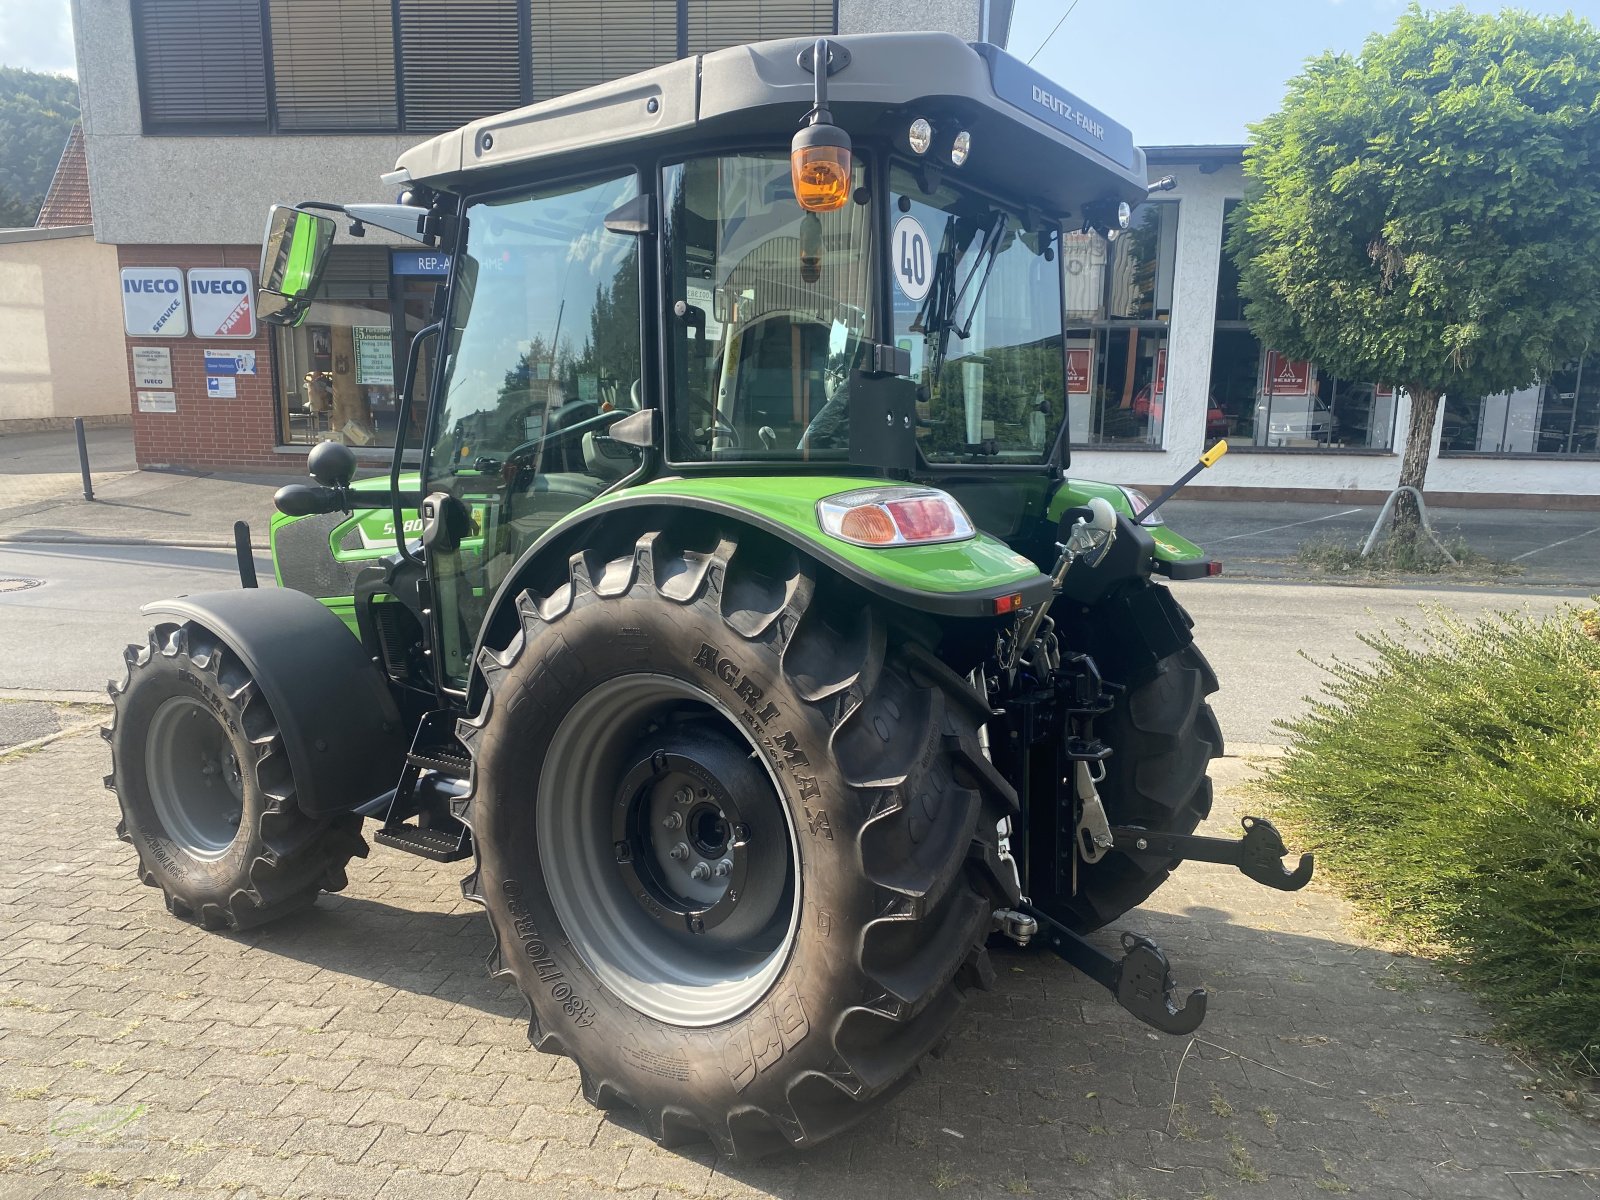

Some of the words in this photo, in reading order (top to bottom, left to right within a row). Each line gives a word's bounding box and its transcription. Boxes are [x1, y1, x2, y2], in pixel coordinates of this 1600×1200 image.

[1032, 84, 1105, 141] DEUTZ-FAHR
[901, 230, 926, 287] 40
[123, 279, 179, 294] IVECO
[191, 280, 248, 295] IVECO
[152, 298, 181, 333] SERVICE
[219, 300, 250, 335] PARTS
[692, 641, 781, 727] AGRI
[772, 729, 834, 842] MAX
[502, 878, 597, 1029] 480/70R30
